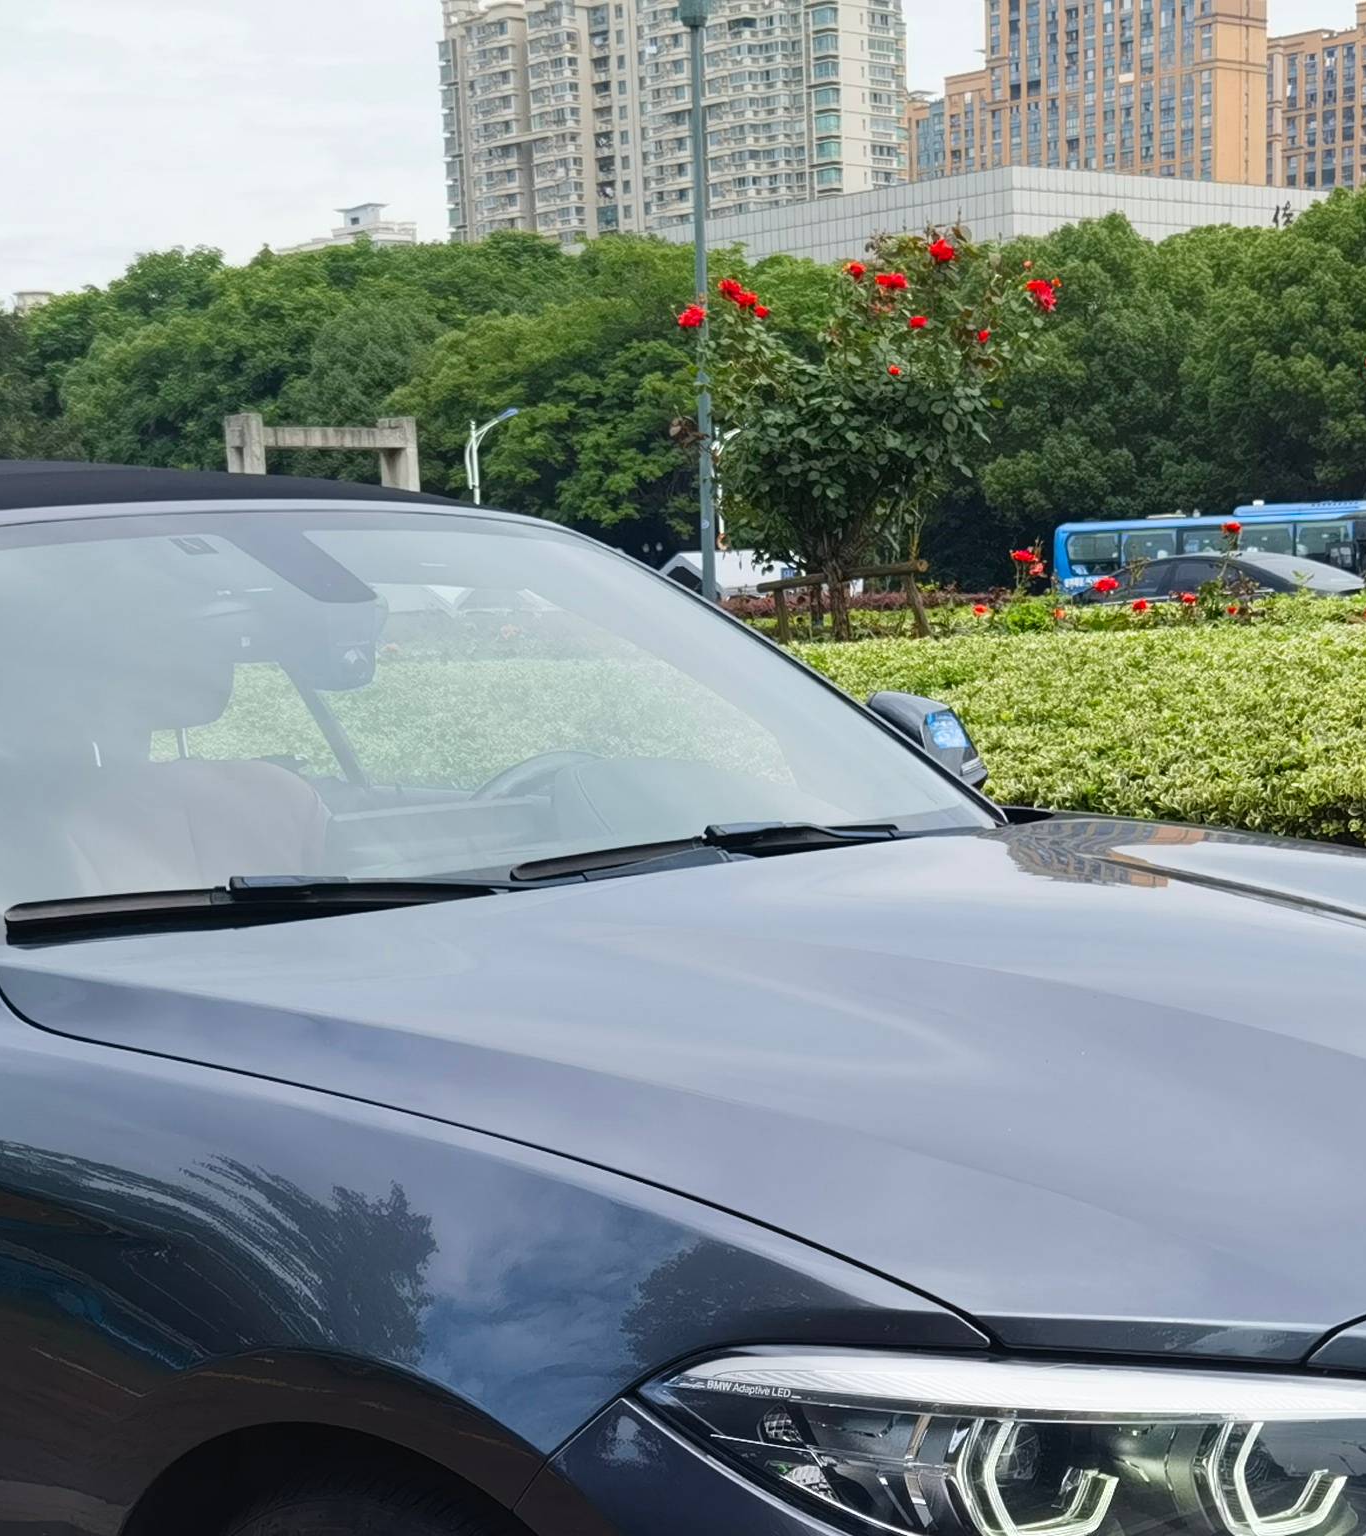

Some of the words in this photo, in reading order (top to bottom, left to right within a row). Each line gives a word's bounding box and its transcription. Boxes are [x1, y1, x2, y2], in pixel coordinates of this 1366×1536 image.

[707, 1380, 733, 1392] BMW
[733, 1383, 771, 1396] Adaptive
[772, 1387, 791, 1398] LED
